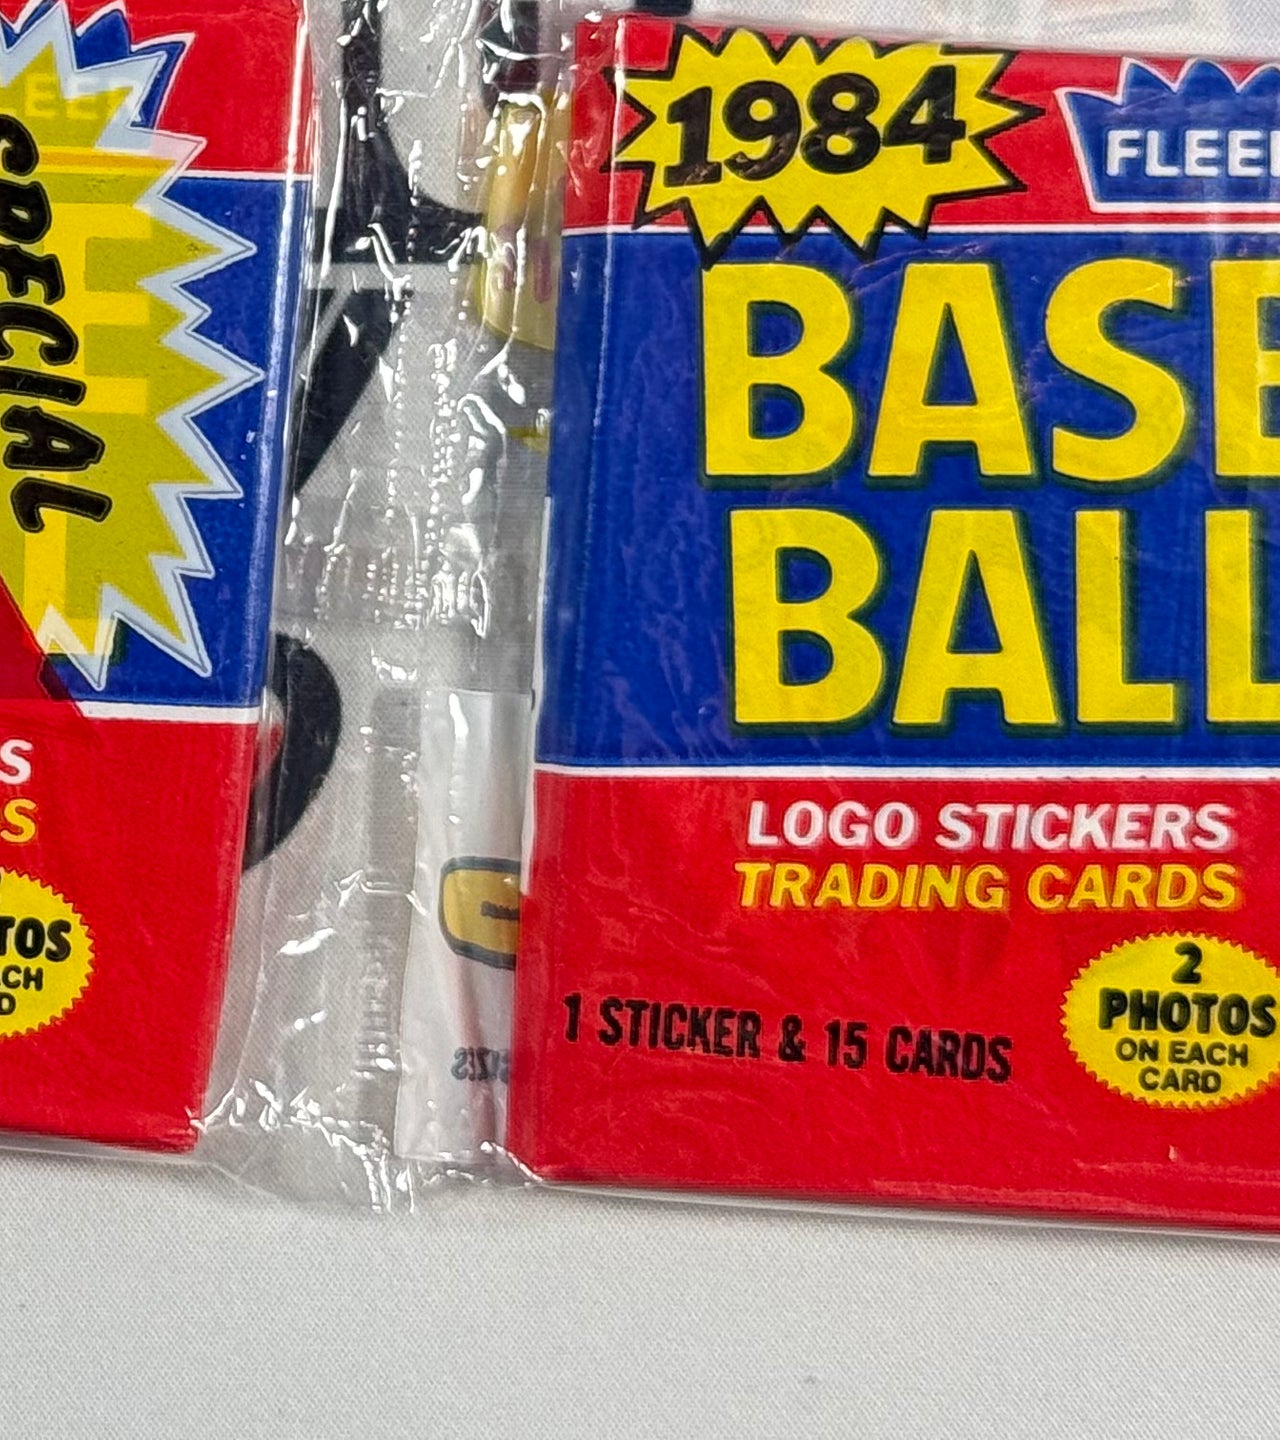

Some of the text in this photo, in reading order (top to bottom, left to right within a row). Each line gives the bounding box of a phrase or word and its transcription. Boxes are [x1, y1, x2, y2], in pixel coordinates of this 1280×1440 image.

[663, 65, 966, 187] 1984
[704, 259, 1280, 481] BASE
[729, 509, 1280, 725] BALL
[746, 801, 1235, 851] LOGO STICKERS
[735, 862, 1239, 910] TRADING CARDS
[1175, 945, 1202, 985] 2
[1099, 988, 1278, 1037] PHOTOS
[563, 992, 1013, 1084] 1 STICKER & 15 CARDS
[1114, 1037, 1249, 1067] ON EACH
[1138, 1066, 1221, 1096] CARD
